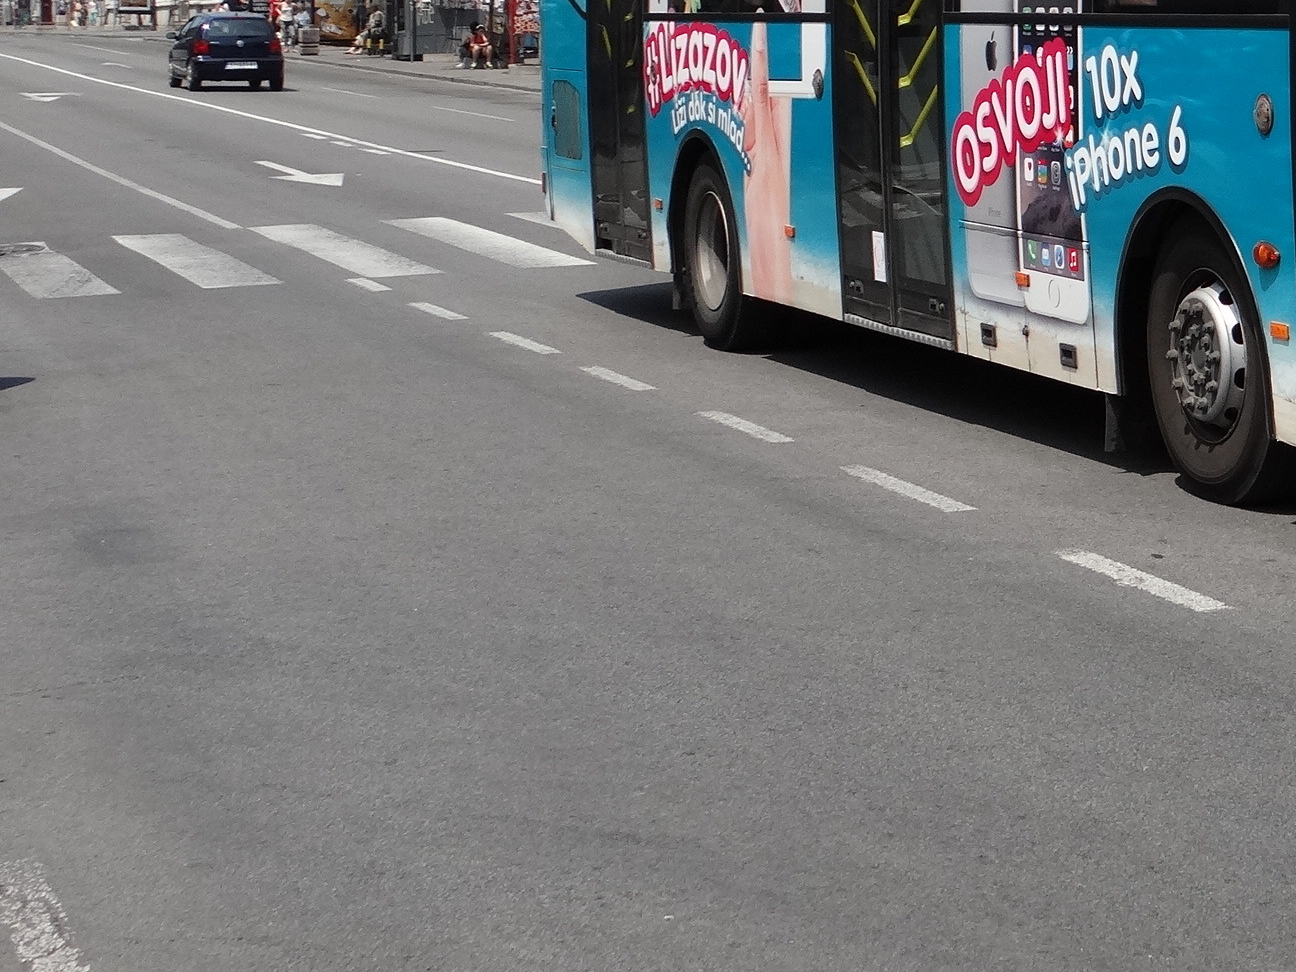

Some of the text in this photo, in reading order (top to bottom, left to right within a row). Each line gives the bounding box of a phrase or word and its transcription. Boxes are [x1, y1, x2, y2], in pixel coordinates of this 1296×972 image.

[708, 96, 716, 124] si
[1086, 44, 1142, 119] 10x
[1066, 105, 1187, 211] iPhone 6
